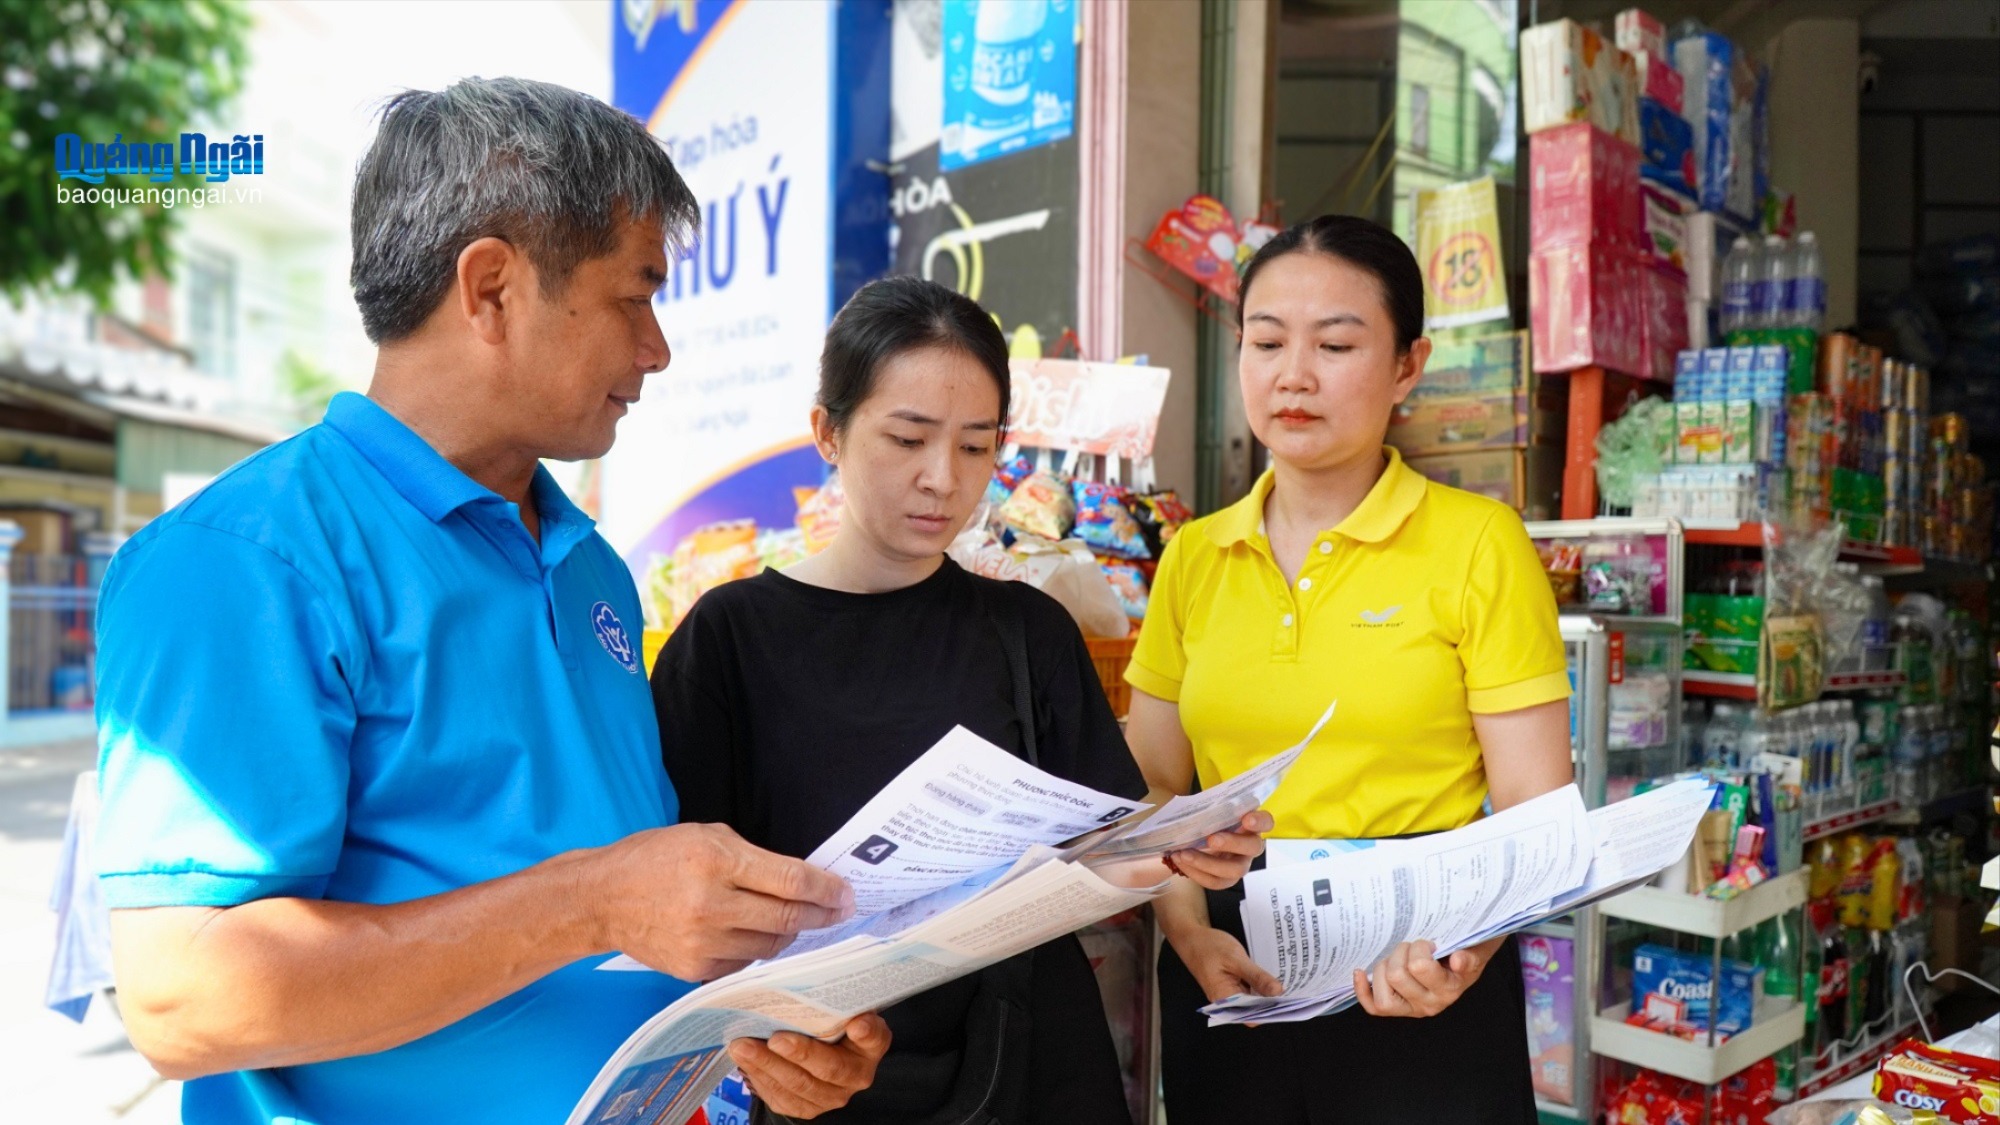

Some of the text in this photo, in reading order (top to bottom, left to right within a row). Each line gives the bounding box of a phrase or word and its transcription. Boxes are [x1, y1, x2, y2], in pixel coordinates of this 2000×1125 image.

[655, 153, 789, 305] HƯ Ý
[866, 843, 890, 860] 4
[1273, 910, 1284, 944] THAM
[1296, 895, 1308, 938] DOANH
[1659, 978, 1714, 1000] Coast
[1894, 1089, 1947, 1112] COSY
